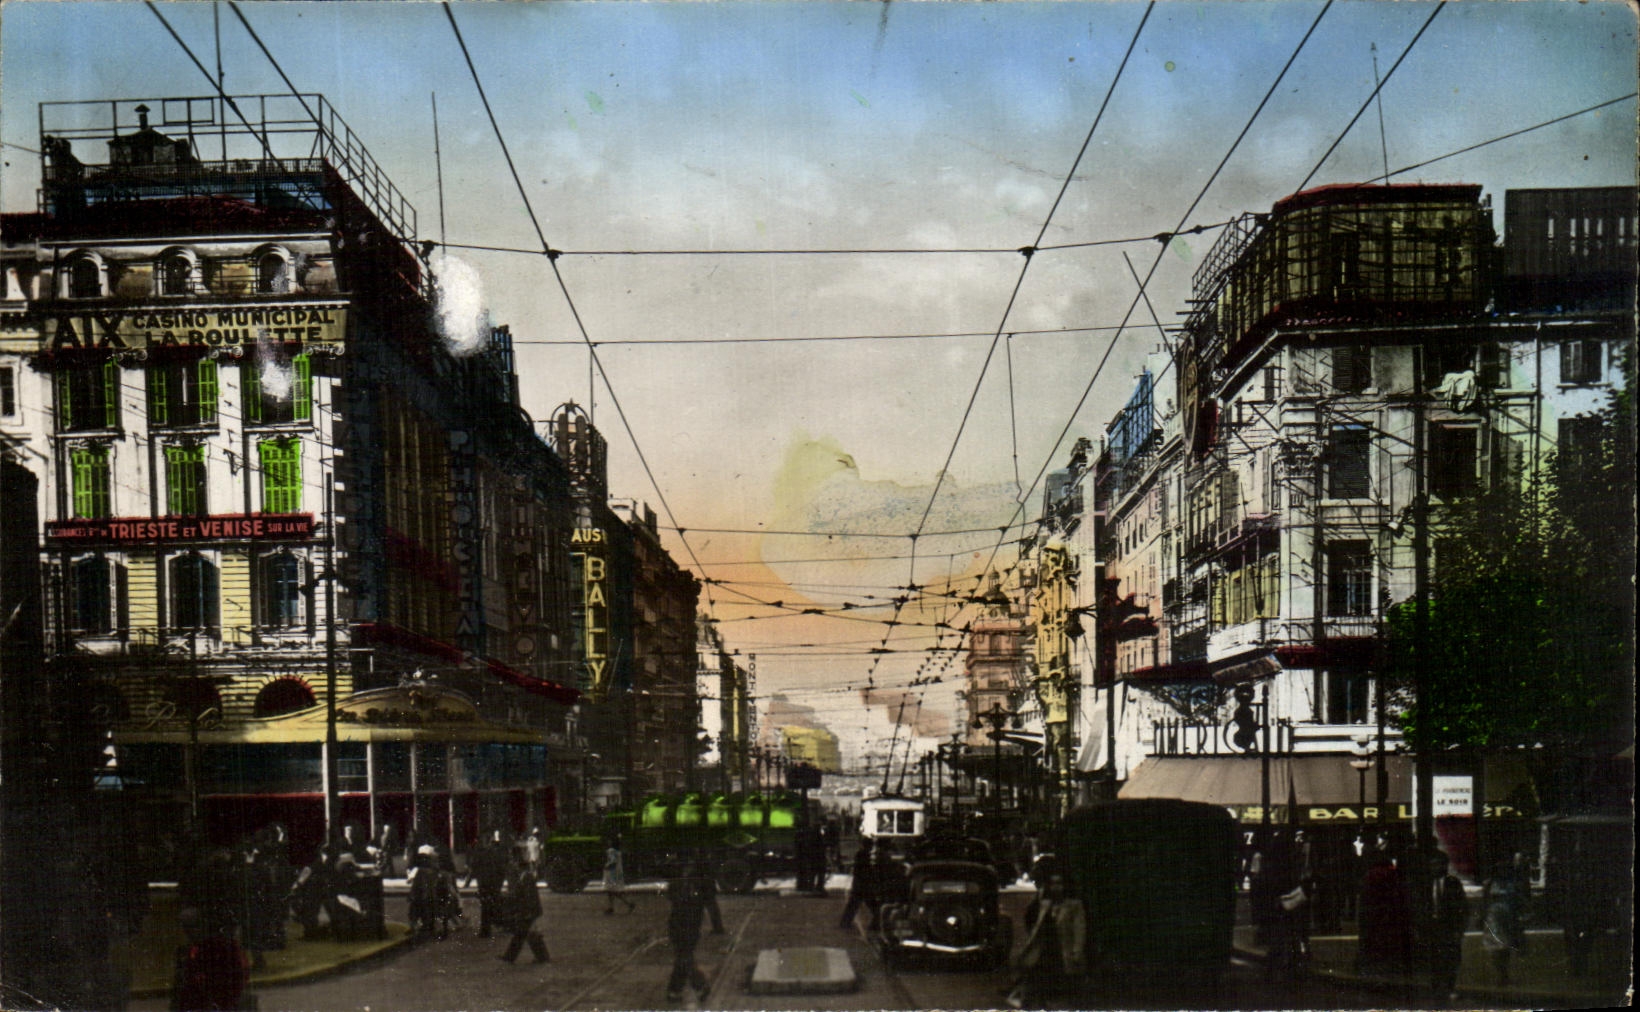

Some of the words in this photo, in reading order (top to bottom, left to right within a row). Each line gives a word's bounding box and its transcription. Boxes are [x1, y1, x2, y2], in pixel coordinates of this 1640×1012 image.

[134, 312, 206, 328] CASINO
[218, 309, 335, 326] MUNICIPAL
[53, 313, 127, 349] AIX
[146, 330, 179, 347] LA
[109, 522, 178, 539] TRIESTE
[183, 527, 197, 537] ET
[200, 519, 264, 537] VENISE
[267, 523, 282, 533] SUR
[285, 523, 296, 533] LA
[587, 556, 607, 686] BALLY
[1308, 806, 1379, 820] BAR
